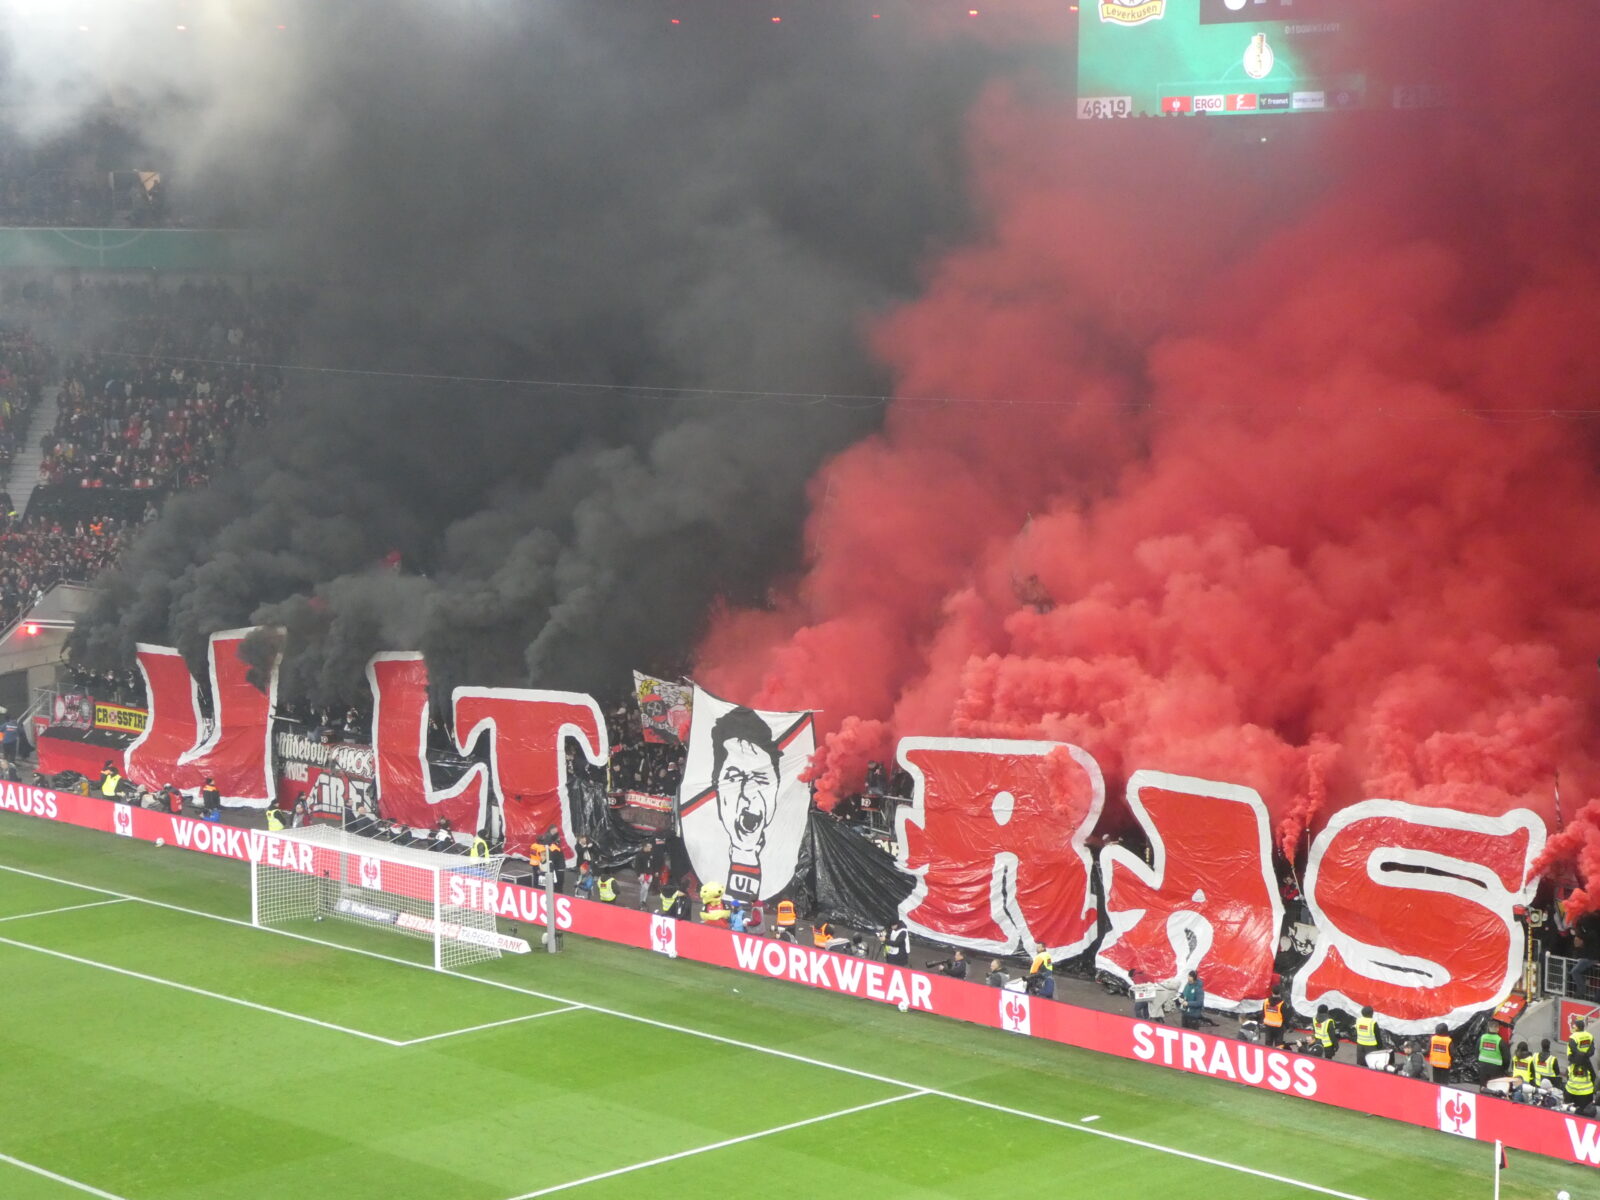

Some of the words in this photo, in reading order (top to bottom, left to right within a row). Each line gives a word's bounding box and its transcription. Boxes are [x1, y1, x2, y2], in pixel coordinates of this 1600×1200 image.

[1106, 4, 1158, 19] Leverkusen
[1082, 98, 1126, 117] 46:19
[1194, 98, 1222, 110] ERGO
[171, 817, 314, 873] WORKWEAR
[732, 934, 933, 1010] WORKWEAR
[1132, 1023, 1318, 1097] STRAUSS
